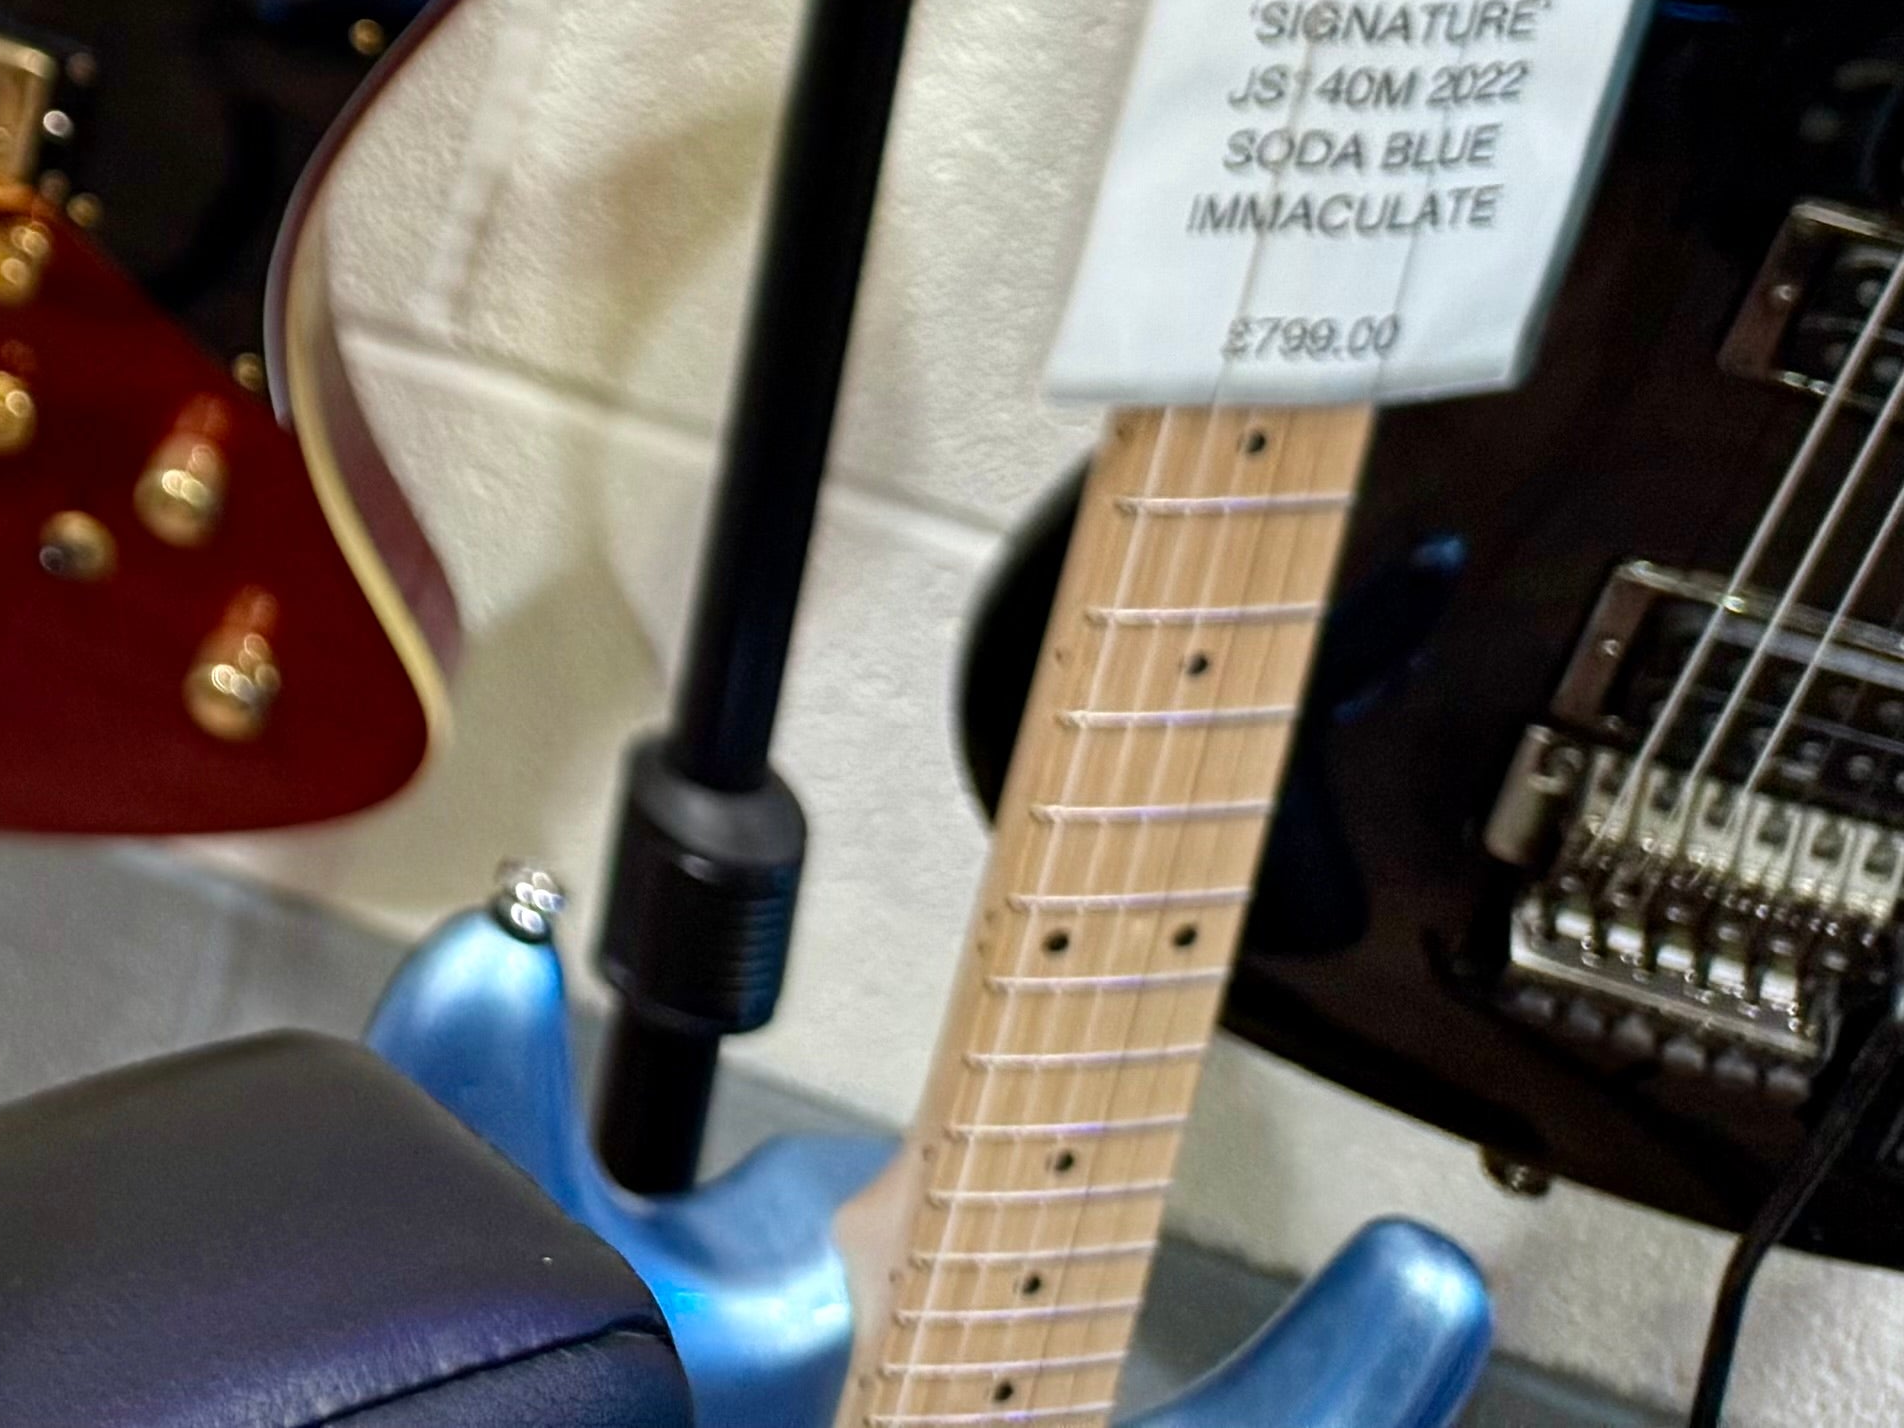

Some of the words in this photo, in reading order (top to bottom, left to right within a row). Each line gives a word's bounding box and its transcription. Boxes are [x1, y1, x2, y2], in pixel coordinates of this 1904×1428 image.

[1425, 58, 1533, 108] 2022
[1222, 126, 1365, 173] SODA
[1379, 120, 1505, 173] BLUE
[1186, 183, 1506, 235] IMMACULATE
[1220, 310, 1403, 361] £799.00
